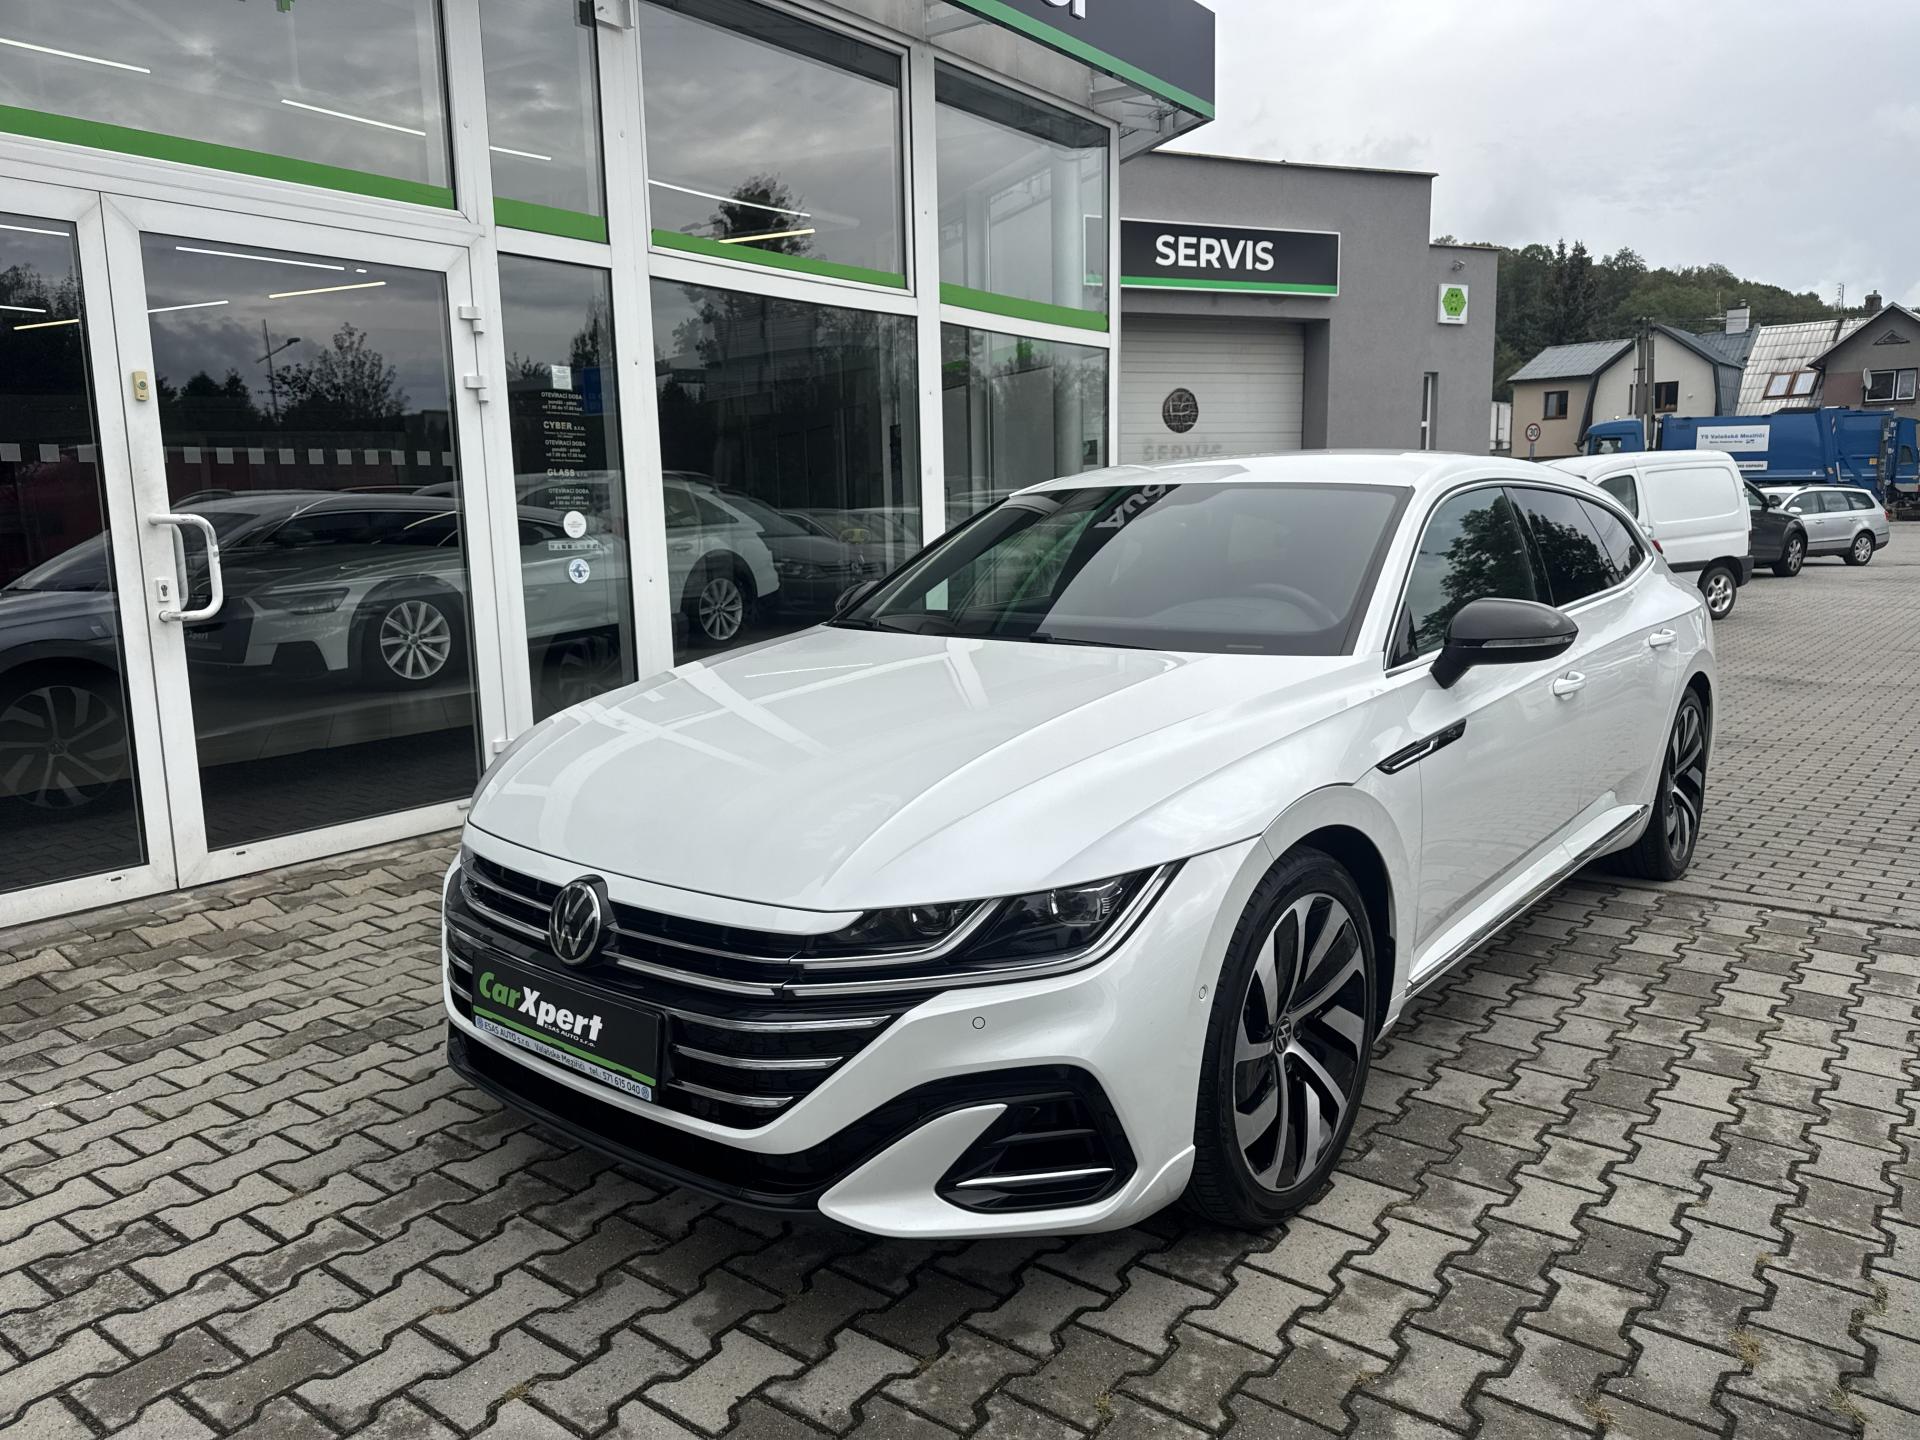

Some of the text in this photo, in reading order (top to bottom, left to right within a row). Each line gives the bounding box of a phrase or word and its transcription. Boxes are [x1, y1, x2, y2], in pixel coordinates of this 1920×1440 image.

[1155, 234, 1275, 271] SERVIS
[543, 421, 572, 430] CYBER
[1529, 427, 1537, 437] 30
[547, 468, 575, 476] GLASS
[544, 1023, 560, 1034] ESAS
[560, 1030, 579, 1041] AUTO
[484, 1021, 499, 1034] ESAS
[500, 1028, 516, 1041] AUTO
[602, 1070, 614, 1083] 571
[614, 1077, 626, 1089] 615
[626, 1082, 640, 1094] 040
